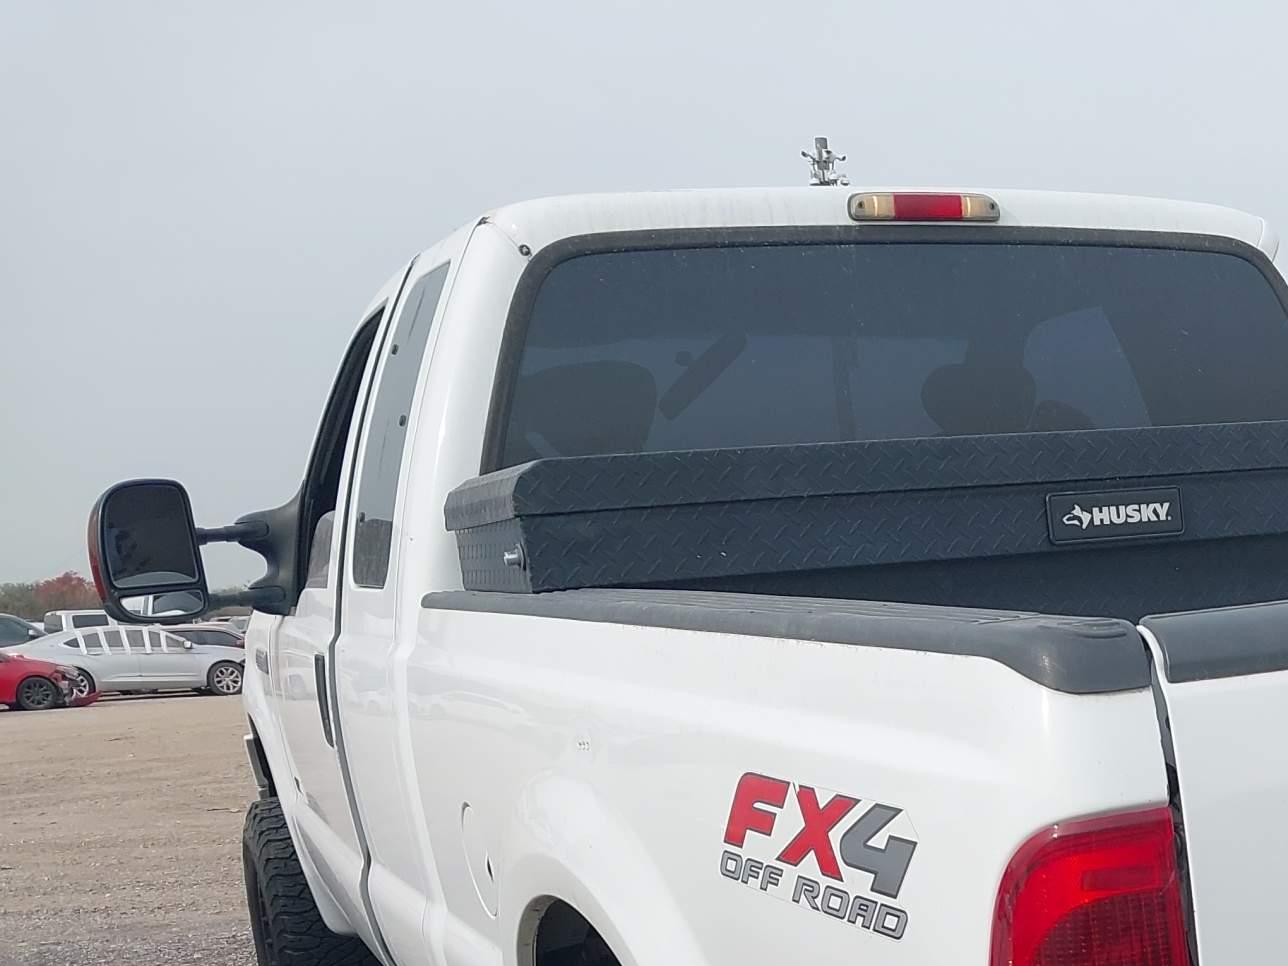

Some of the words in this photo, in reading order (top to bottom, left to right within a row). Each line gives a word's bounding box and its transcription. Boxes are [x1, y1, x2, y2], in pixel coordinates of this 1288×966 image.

[1092, 501, 1171, 526] HUSKY
[723, 771, 919, 899] FX4
[719, 849, 784, 891] OFF
[792, 875, 909, 941] ROAD
